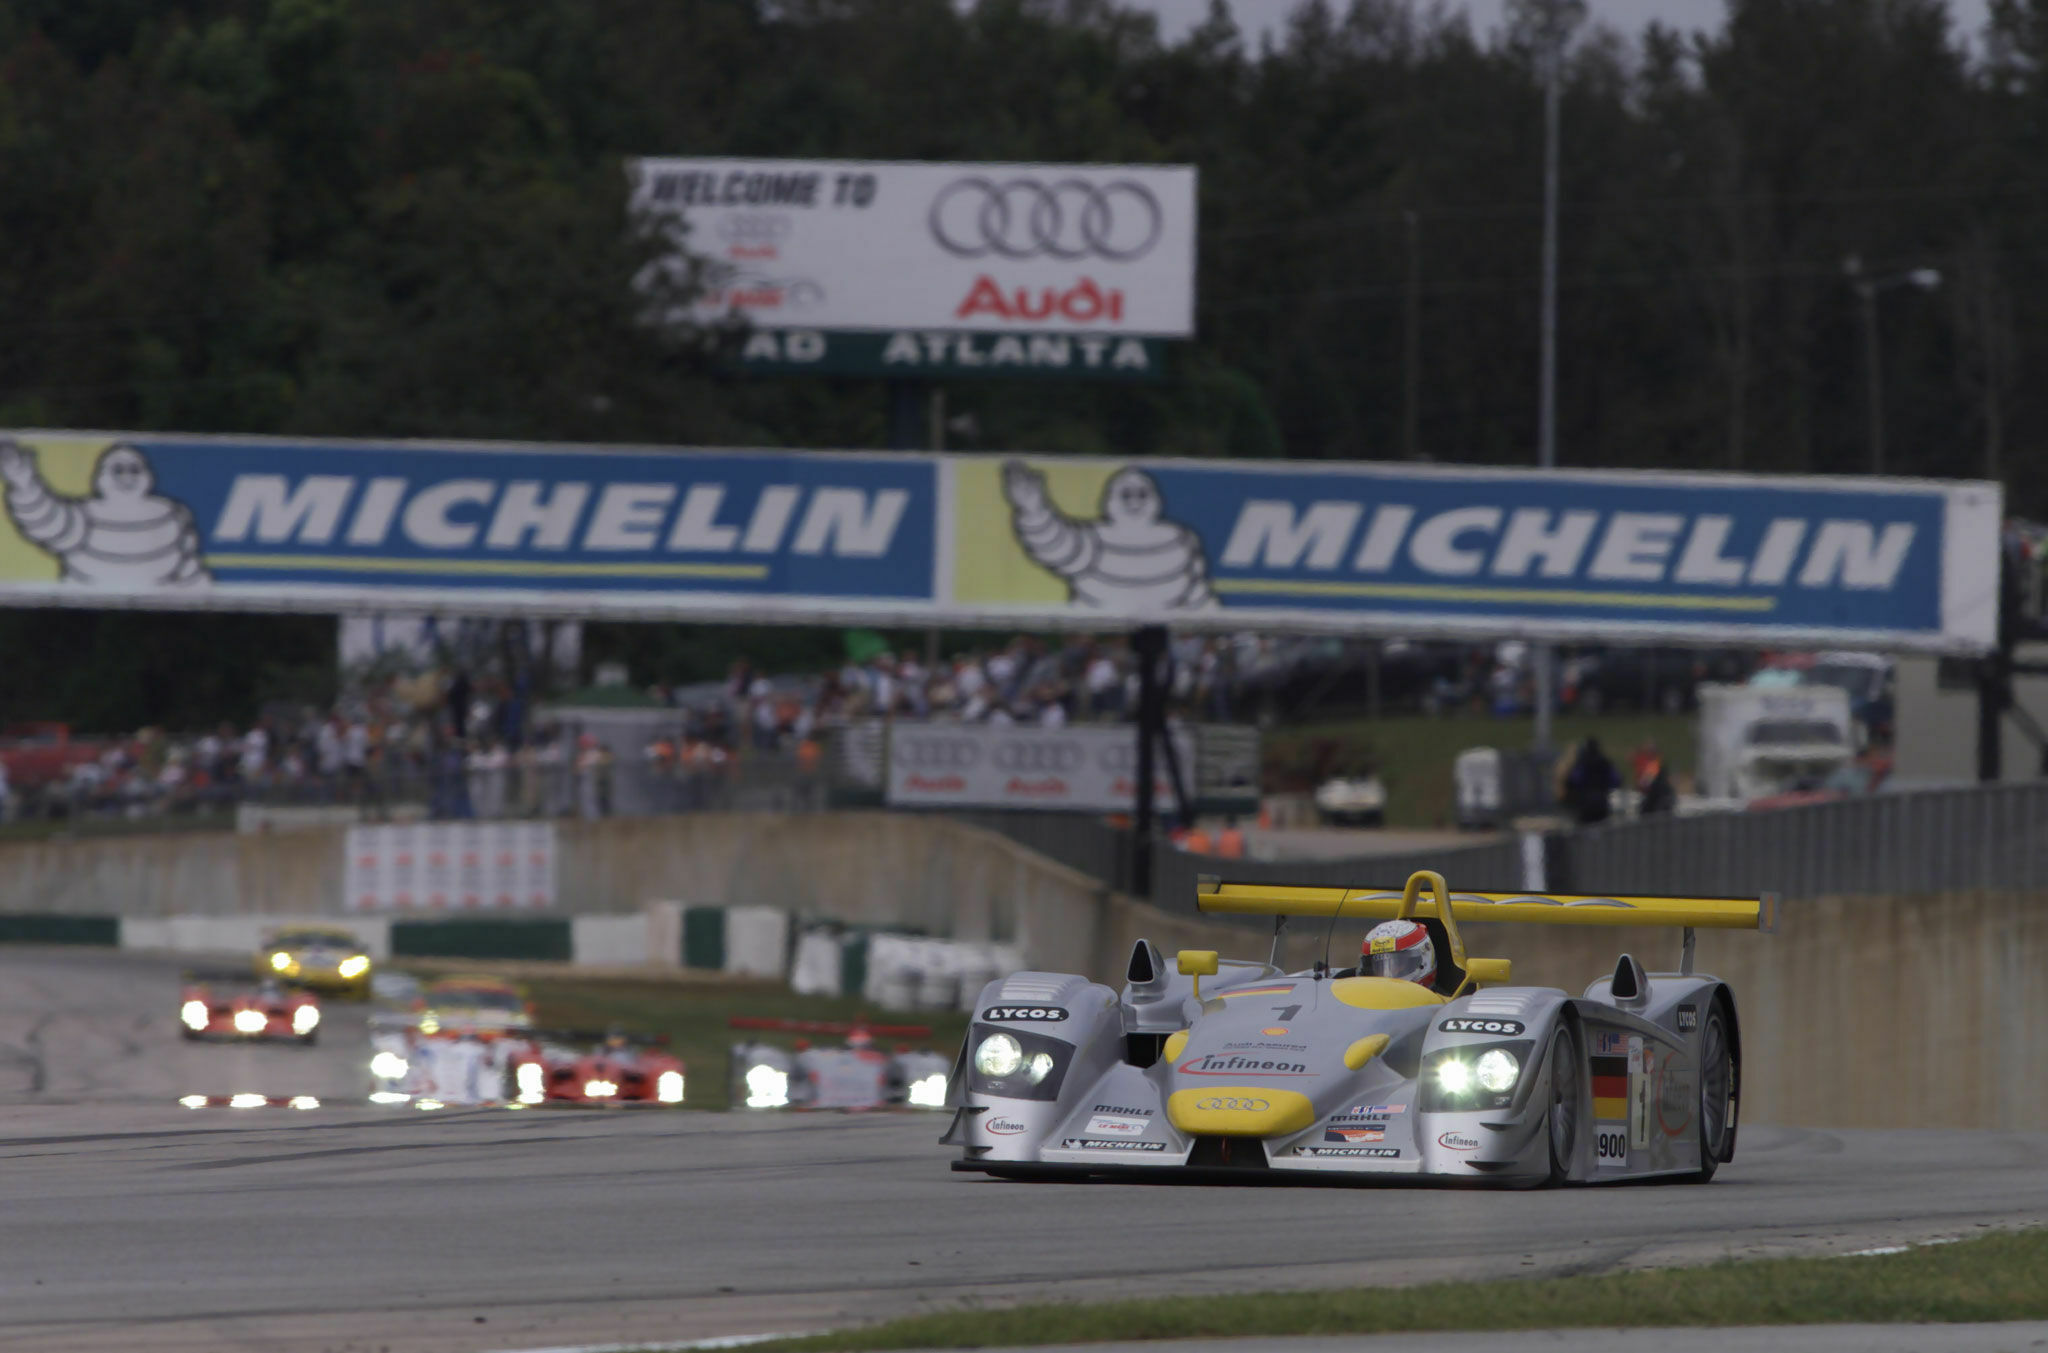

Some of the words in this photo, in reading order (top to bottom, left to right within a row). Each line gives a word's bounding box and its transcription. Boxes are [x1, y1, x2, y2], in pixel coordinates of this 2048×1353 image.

[651, 171, 821, 208] WELCOME
[834, 173, 878, 210] TO
[956, 275, 1124, 321] Audi
[882, 333, 1148, 369] ATLANTA
[212, 474, 909, 556] MICHELIN
[1220, 500, 1917, 591] MICHELIN
[989, 1009, 1060, 1019] LYCOS
[1271, 1004, 1302, 1022] 1
[1446, 1020, 1517, 1033] LYCOS
[1094, 1105, 1154, 1115] MAHLE
[1331, 1114, 1391, 1122] MAHLE
[1086, 1141, 1162, 1150] MICHELIN
[1317, 1148, 1396, 1156] MICHELIN
